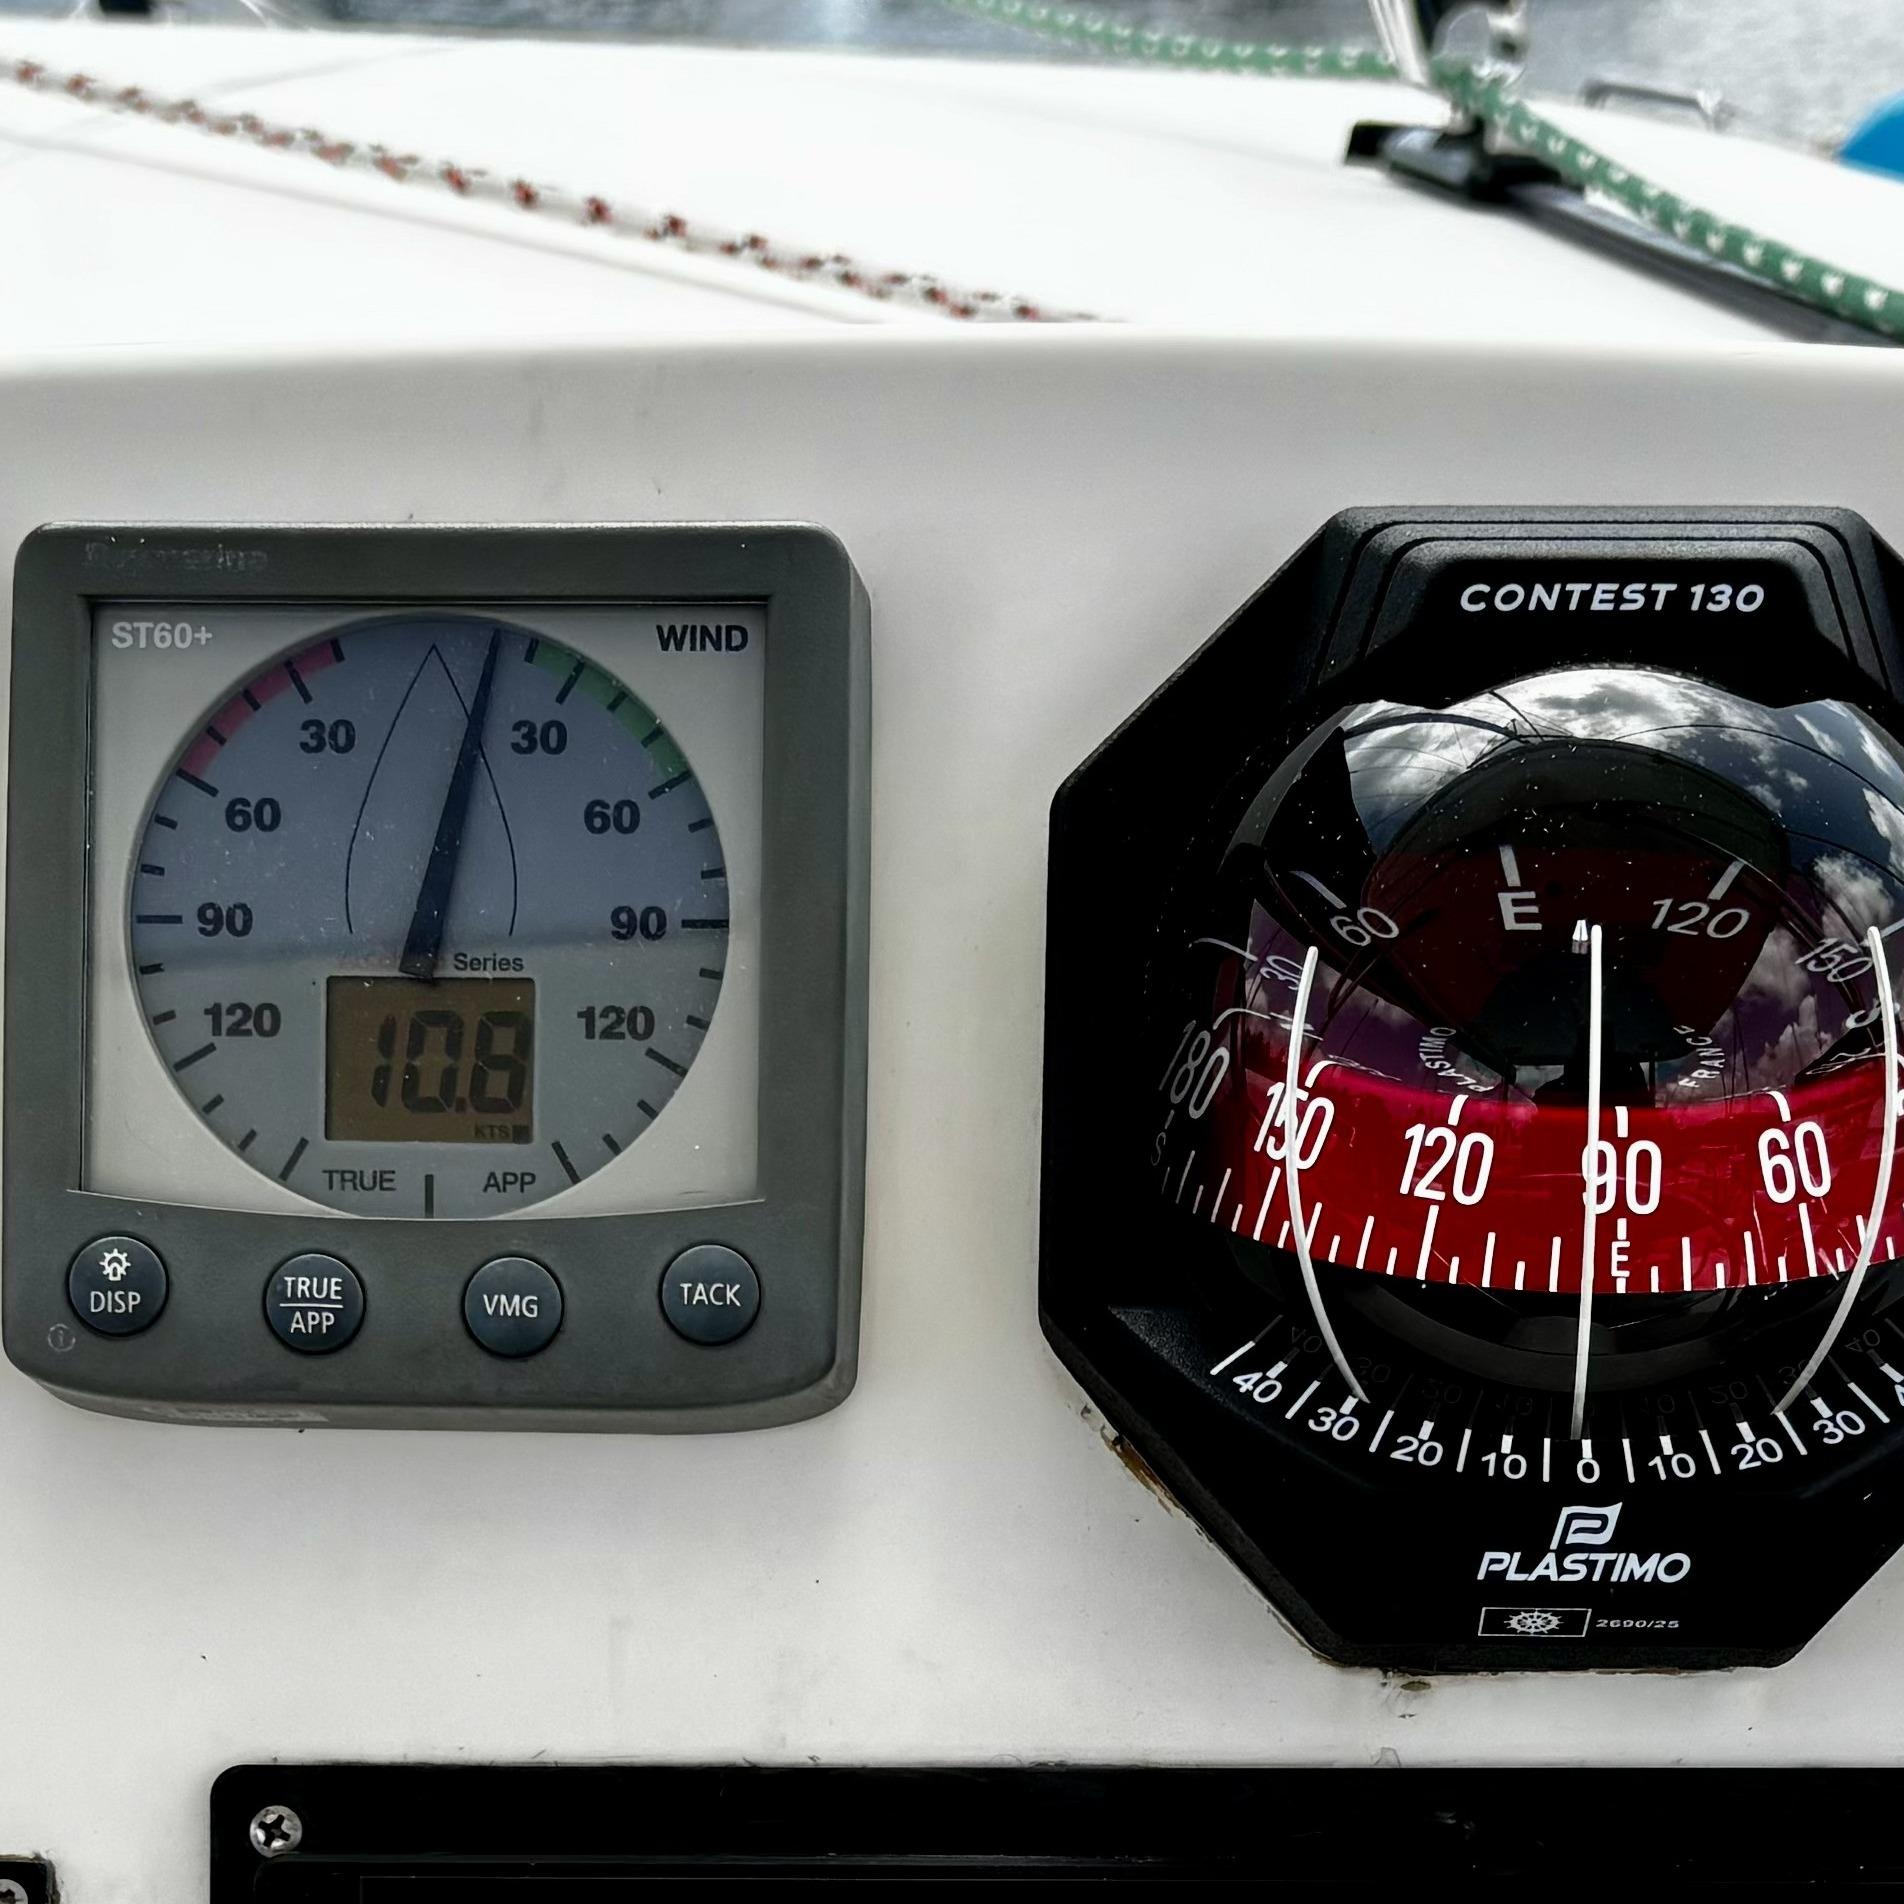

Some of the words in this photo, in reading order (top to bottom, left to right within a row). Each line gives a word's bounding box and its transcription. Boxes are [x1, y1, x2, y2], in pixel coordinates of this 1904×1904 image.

[1460, 582, 1669, 613] CONTEST
[1689, 582, 1765, 613] 130
[110, 621, 214, 651] ST60+
[655, 624, 749, 653] WIND
[299, 718, 357, 756] 30
[511, 718, 569, 756] 30
[225, 797, 283, 834] 60
[583, 799, 641, 836] 60
[196, 901, 254, 938] 90
[610, 905, 668, 942] 90
[1329, 905, 1400, 948] 60
[1497, 890, 1543, 932] E
[1651, 896, 1751, 940] 120
[453, 951, 524, 974] Series
[1795, 937, 1875, 984] 150
[203, 1002, 282, 1038] 120
[577, 1005, 656, 1042] 120
[371, 1010, 532, 1114] 10.8
[1159, 1019, 1230, 1120] 180
[1418, 1026, 1494, 1093] PLASTIMO
[474, 1123, 511, 1140] KTS
[1253, 1081, 1335, 1170] 150
[1398, 1121, 1496, 1206] 120
[1581, 1137, 1663, 1215] 90
[1757, 1119, 1832, 1204] 60
[322, 1168, 397, 1193] TRUE
[482, 1170, 537, 1194] APP
[1611, 1239, 1632, 1278] E
[89, 1290, 142, 1316] DISP
[283, 1276, 343, 1302] TRUE
[482, 1293, 539, 1319] VMG
[679, 1282, 741, 1307] TACK
[289, 1309, 336, 1335] APP
[1231, 1369, 1284, 1404] 40
[1307, 1406, 1361, 1442] 30
[1812, 1408, 1867, 1446] 30
[1390, 1434, 1445, 1468] 20
[1479, 1452, 1527, 1480] 10
[1576, 1454, 1600, 1484] 0
[1647, 1450, 1697, 1480] 10
[1731, 1436, 1784, 1471] 20
[1476, 1551, 1691, 1583] PLASTIMO
